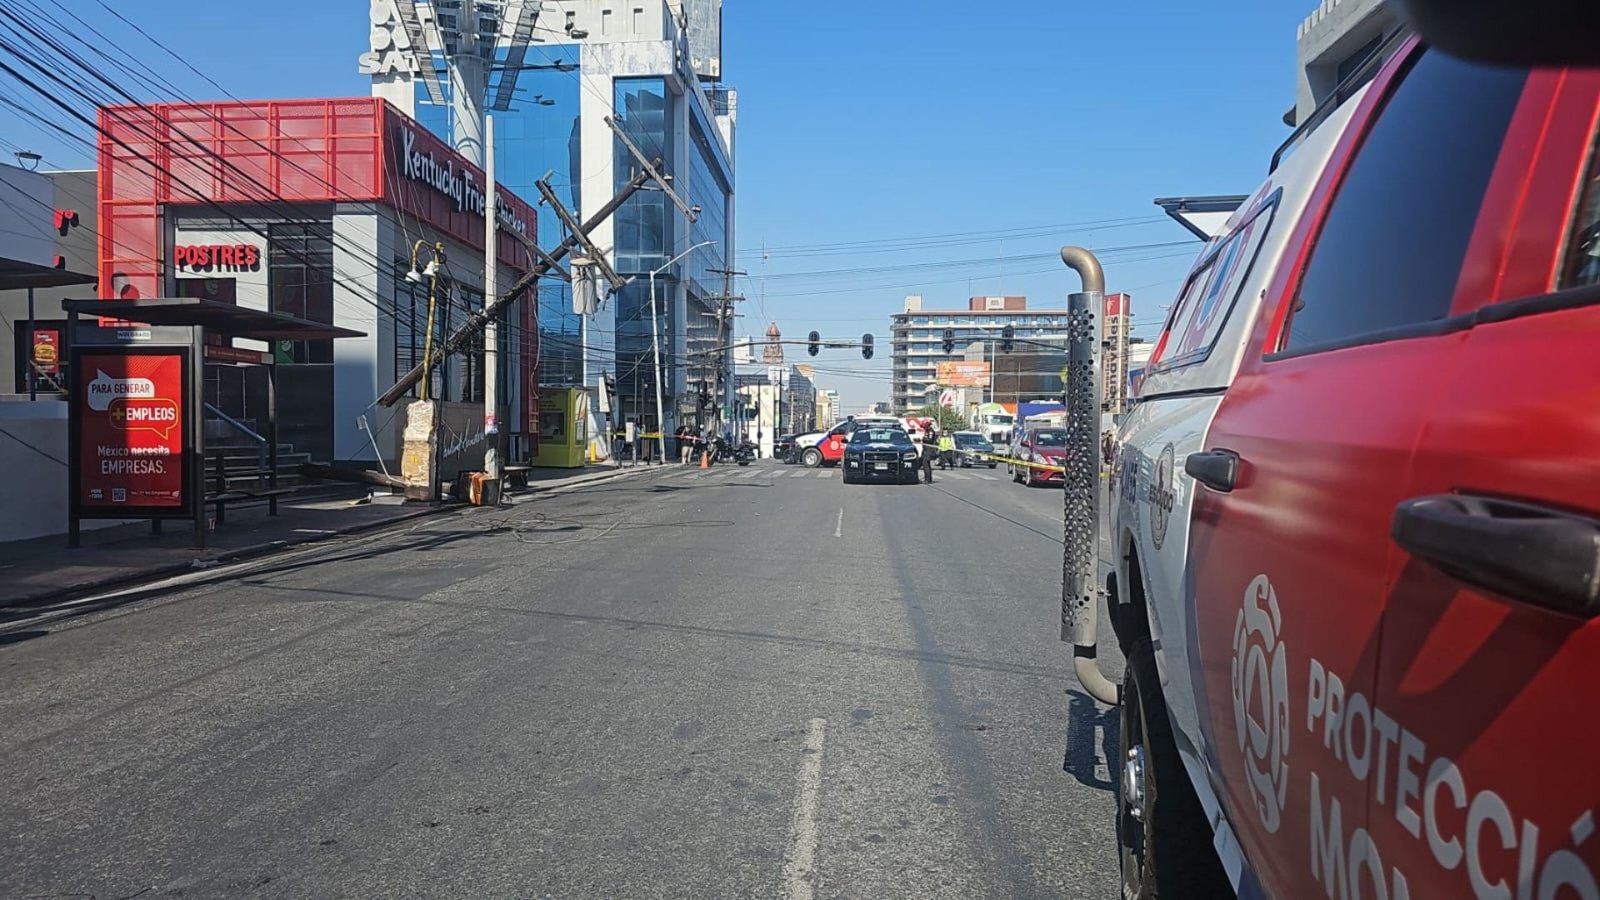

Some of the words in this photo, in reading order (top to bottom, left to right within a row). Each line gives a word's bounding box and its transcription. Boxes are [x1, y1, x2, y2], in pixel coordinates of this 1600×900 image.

[403, 126, 462, 213] Kentucky
[463, 169, 487, 217] Frie
[174, 244, 258, 266] POSTRES
[91, 383, 113, 394] PARA
[114, 383, 151, 394] GENERAR
[97, 445, 129, 457] México
[131, 444, 170, 456] necesita
[101, 460, 167, 474] EMPRESAS.
